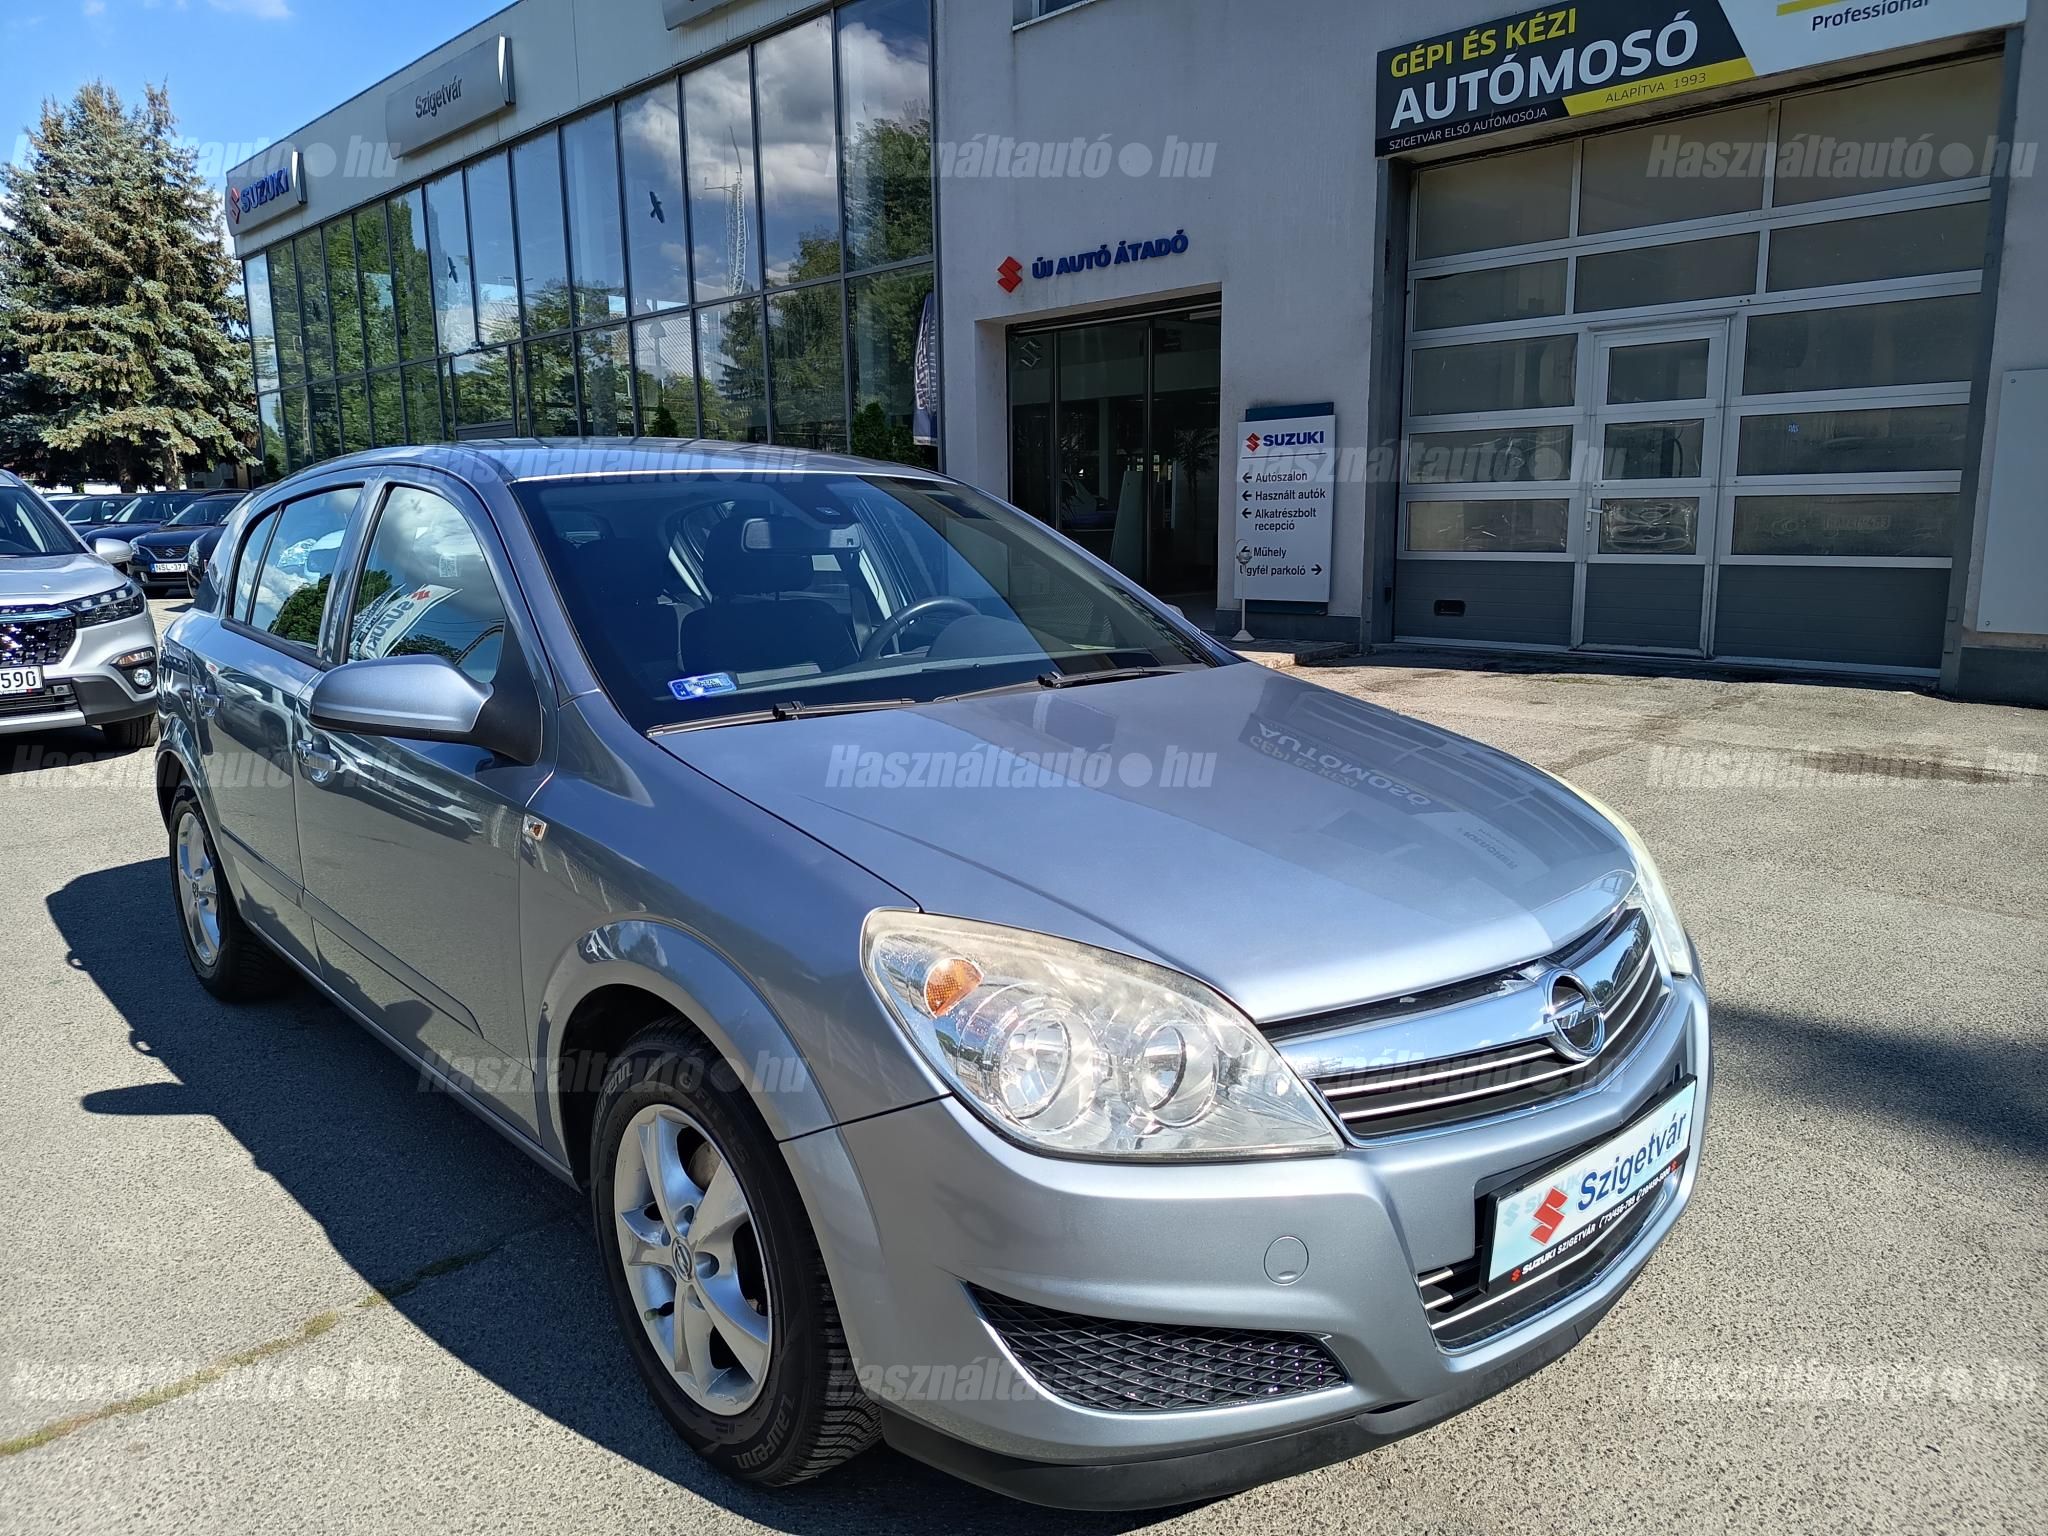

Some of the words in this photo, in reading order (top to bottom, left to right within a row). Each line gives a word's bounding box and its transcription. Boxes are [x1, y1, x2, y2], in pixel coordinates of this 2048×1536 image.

[1391, 41, 1452, 78] GÉPI
[1463, 24, 1497, 61] ÉS
[1506, 8, 1576, 49] KÉZI
[1390, 10, 1698, 129] AUTÓMOSÓ
[416, 75, 462, 118] Szigetvár
[1605, 82, 1665, 103] ALAPÍTVA
[1674, 72, 1706, 89] 1993
[1389, 130, 1442, 150] SZIGETVÁR
[1445, 121, 1470, 138] ELSŐ
[1473, 107, 1548, 132] AUTÓMOSÓJA
[240, 167, 290, 213] SUZUKI
[1032, 257, 1053, 279] ÚJ
[1056, 244, 1111, 275] AUTÓ
[1114, 229, 1189, 264] ÁTADÓ
[1263, 431, 1325, 447] SUZUKI
[1255, 471, 1308, 483] Autószalon
[1255, 489, 1296, 501] Használt
[1298, 488, 1326, 500] autók
[1255, 507, 1317, 519] Alkatrészbolt
[1255, 520, 1296, 532] recepció
[1253, 546, 1287, 559] Műhely
[1271, 564, 1306, 577] parkoló
[0, 671, 37, 688] 590
[1577, 1112, 1687, 1211] Szigetvár
[1521, 1248, 1557, 1275] SUZUKI
[1557, 1223, 1596, 1254] SZIGETVÁR
